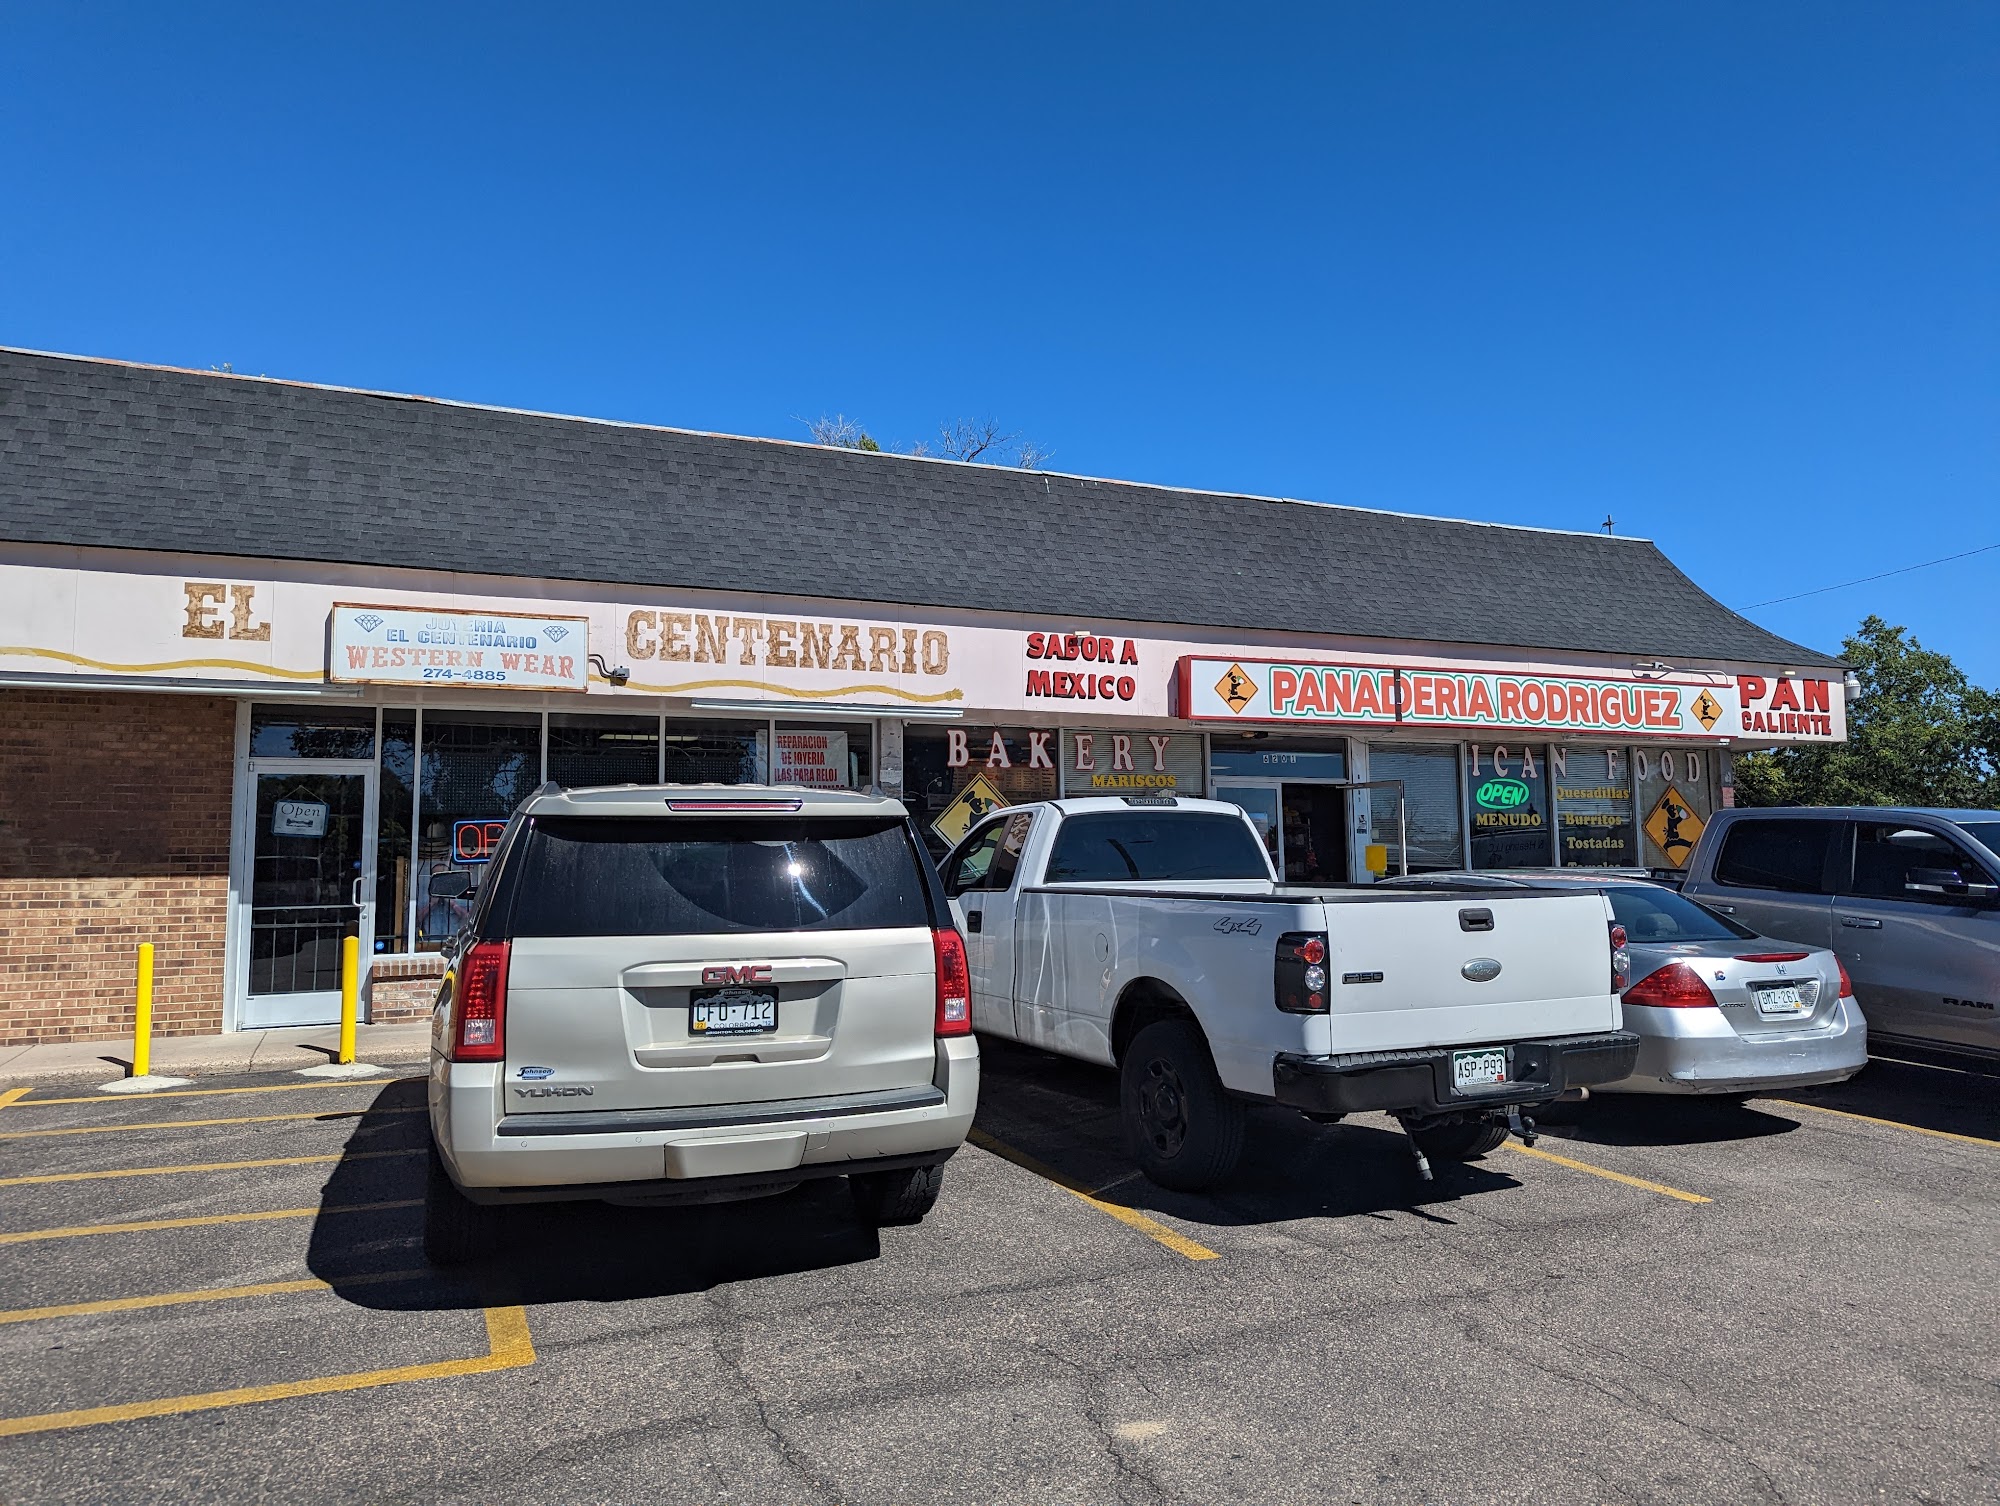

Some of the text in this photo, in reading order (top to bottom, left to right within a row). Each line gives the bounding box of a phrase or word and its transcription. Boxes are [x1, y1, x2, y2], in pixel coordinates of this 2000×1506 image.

[184, 582, 271, 641] EL
[387, 629, 537, 649] EL CENTENARIO
[626, 609, 951, 676] CENTENARIO
[1026, 633, 1139, 666] SABOR A
[346, 645, 575, 679] WESTERN WEAR
[423, 668, 506, 681] 274-4885
[1026, 670, 1136, 701] MEXICO
[1737, 674, 1830, 713] PAN
[1273, 670, 1680, 727] PANADERIA RODRIGUEZ
[1741, 711, 1832, 736] CALIENTE
[777, 735, 828, 749] REPARACION
[947, 729, 1170, 771] BAKERY
[1262, 754, 1297, 764] 6201
[1606, 750, 1700, 782] FOOD
[1091, 774, 1177, 788] MARISCOS
[1480, 784, 1524, 806] OPEN
[1556, 786, 1629, 800] Quesadillas
[281, 803, 320, 819] Open
[1476, 813, 1541, 827] MENUDO
[1565, 813, 1622, 826] Burritos
[1566, 836, 1624, 849] Tostadas
[1213, 917, 1263, 936] 4x4
[702, 965, 773, 985] GMC
[1942, 997, 1994, 1010] RAM
[713, 1021, 756, 1029] COLORADO
[516, 1066, 555, 1077] Johnson
[514, 1086, 594, 1098] YUKON
